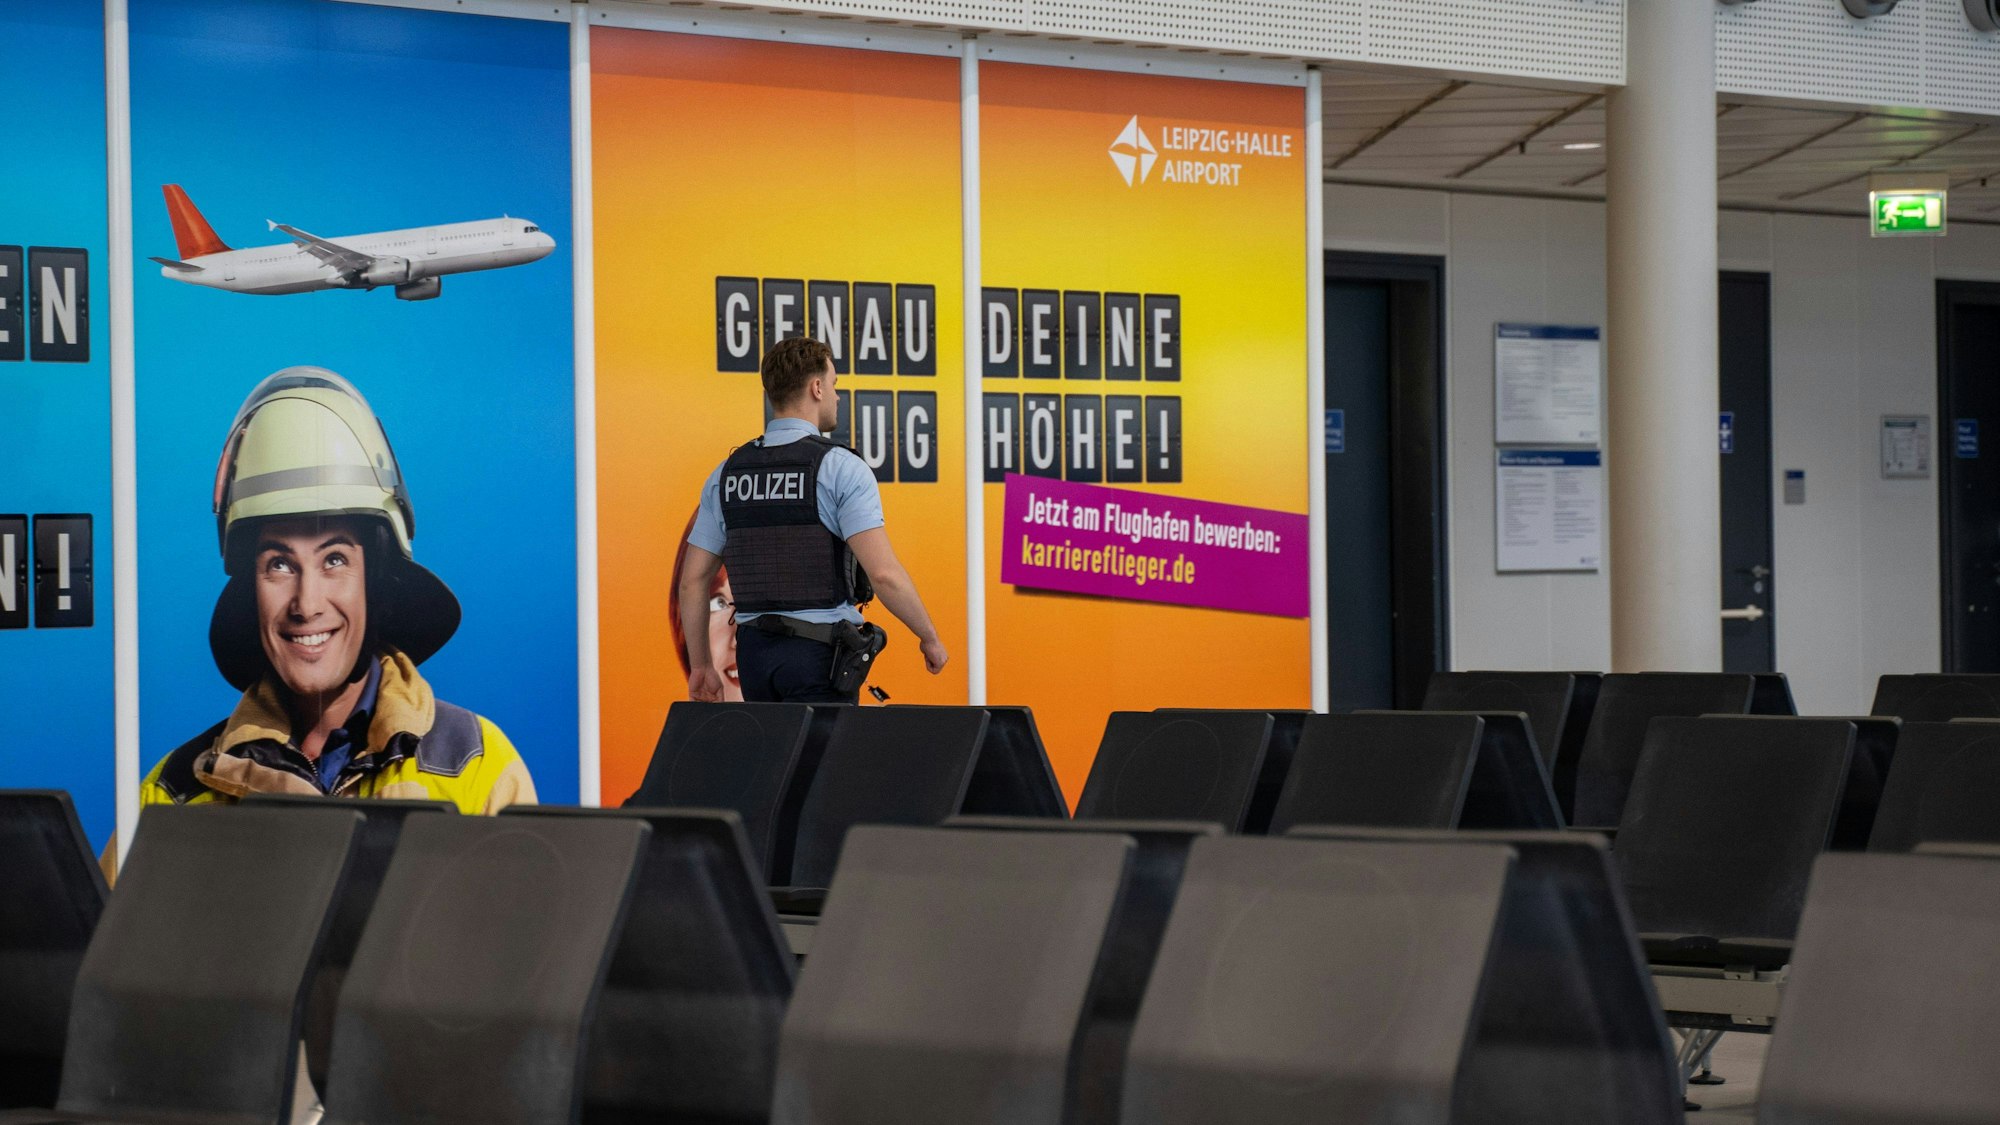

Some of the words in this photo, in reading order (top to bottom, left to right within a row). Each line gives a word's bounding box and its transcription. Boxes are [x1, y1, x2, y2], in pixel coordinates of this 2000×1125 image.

[1162, 160, 1242, 186] AIRPORT
[725, 292, 928, 362] GENAU
[988, 302, 1172, 368] DEINE
[822, 405, 930, 469] UG
[989, 400, 1169, 470] HÖHE!
[725, 472, 805, 502] POLIZEI
[1023, 493, 1069, 527] Jetzt
[1073, 505, 1100, 532] am
[1104, 503, 1190, 544] Flughafen
[1194, 514, 1282, 554] bewerben:
[1022, 535, 1196, 586] karriereflieger.de
